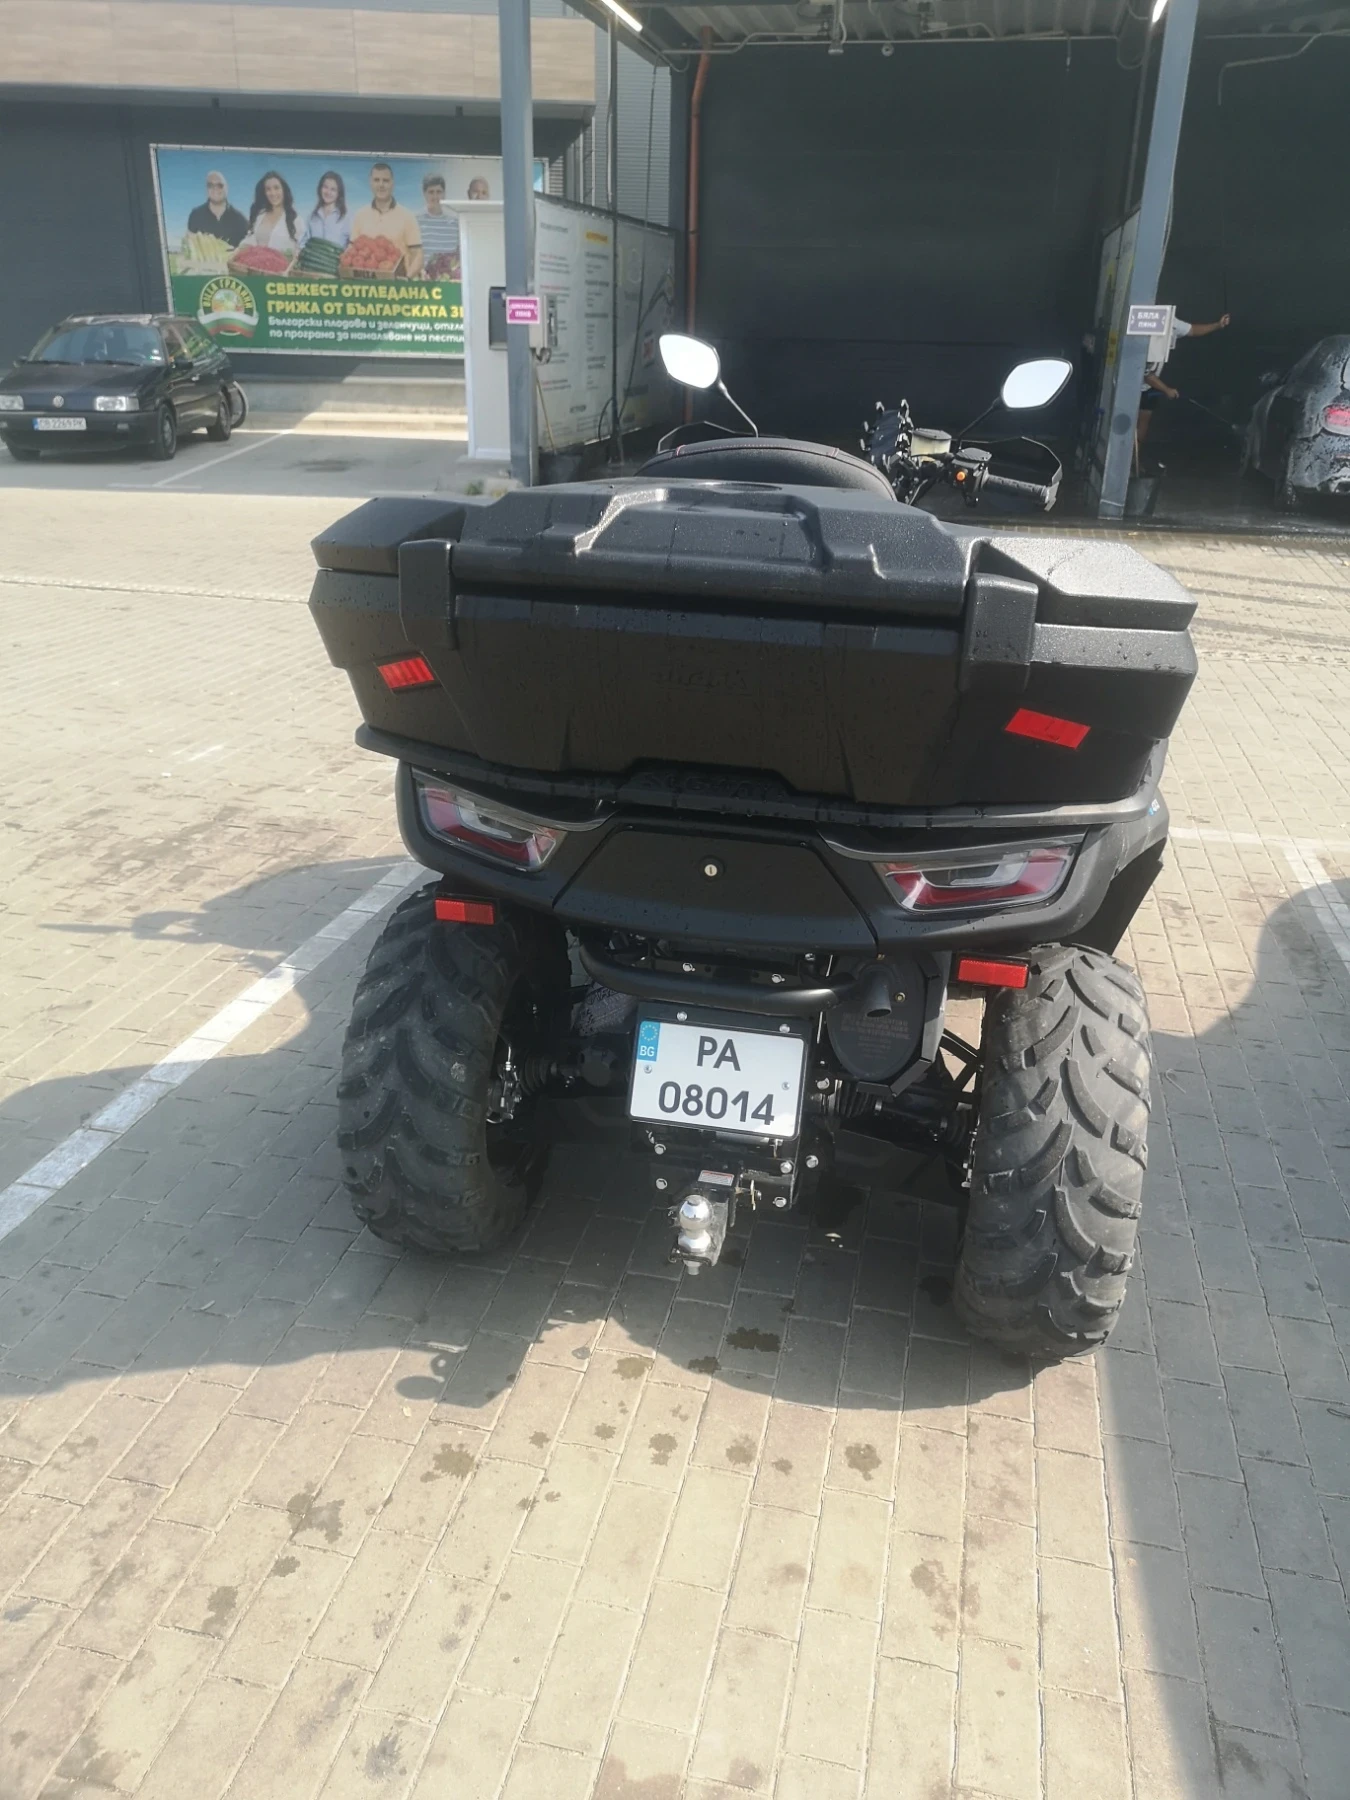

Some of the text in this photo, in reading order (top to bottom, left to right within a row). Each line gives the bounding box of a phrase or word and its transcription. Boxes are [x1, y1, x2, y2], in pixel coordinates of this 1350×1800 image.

[265, 282, 442, 301] СВЕЖЕСТ ОТГЛЕДАНА С
[267, 300, 321, 314] ГРИЖА
[323, 302, 344, 315] ОТ
[346, 303, 448, 318] БЪЛГАРСКАТА
[268, 315, 323, 329] Български
[323, 317, 367, 330] плодове
[368, 321, 376, 329] и
[376, 320, 433, 333] зеленчуци,
[269, 329, 283, 338] по
[284, 330, 336, 341] програма
[336, 331, 349, 342] за
[350, 330, 413, 341] намаляване
[413, 333, 427, 341] на
[639, 1045, 655, 1057] BG
[696, 1035, 741, 1072] PA
[658, 1080, 775, 1126] 08014
